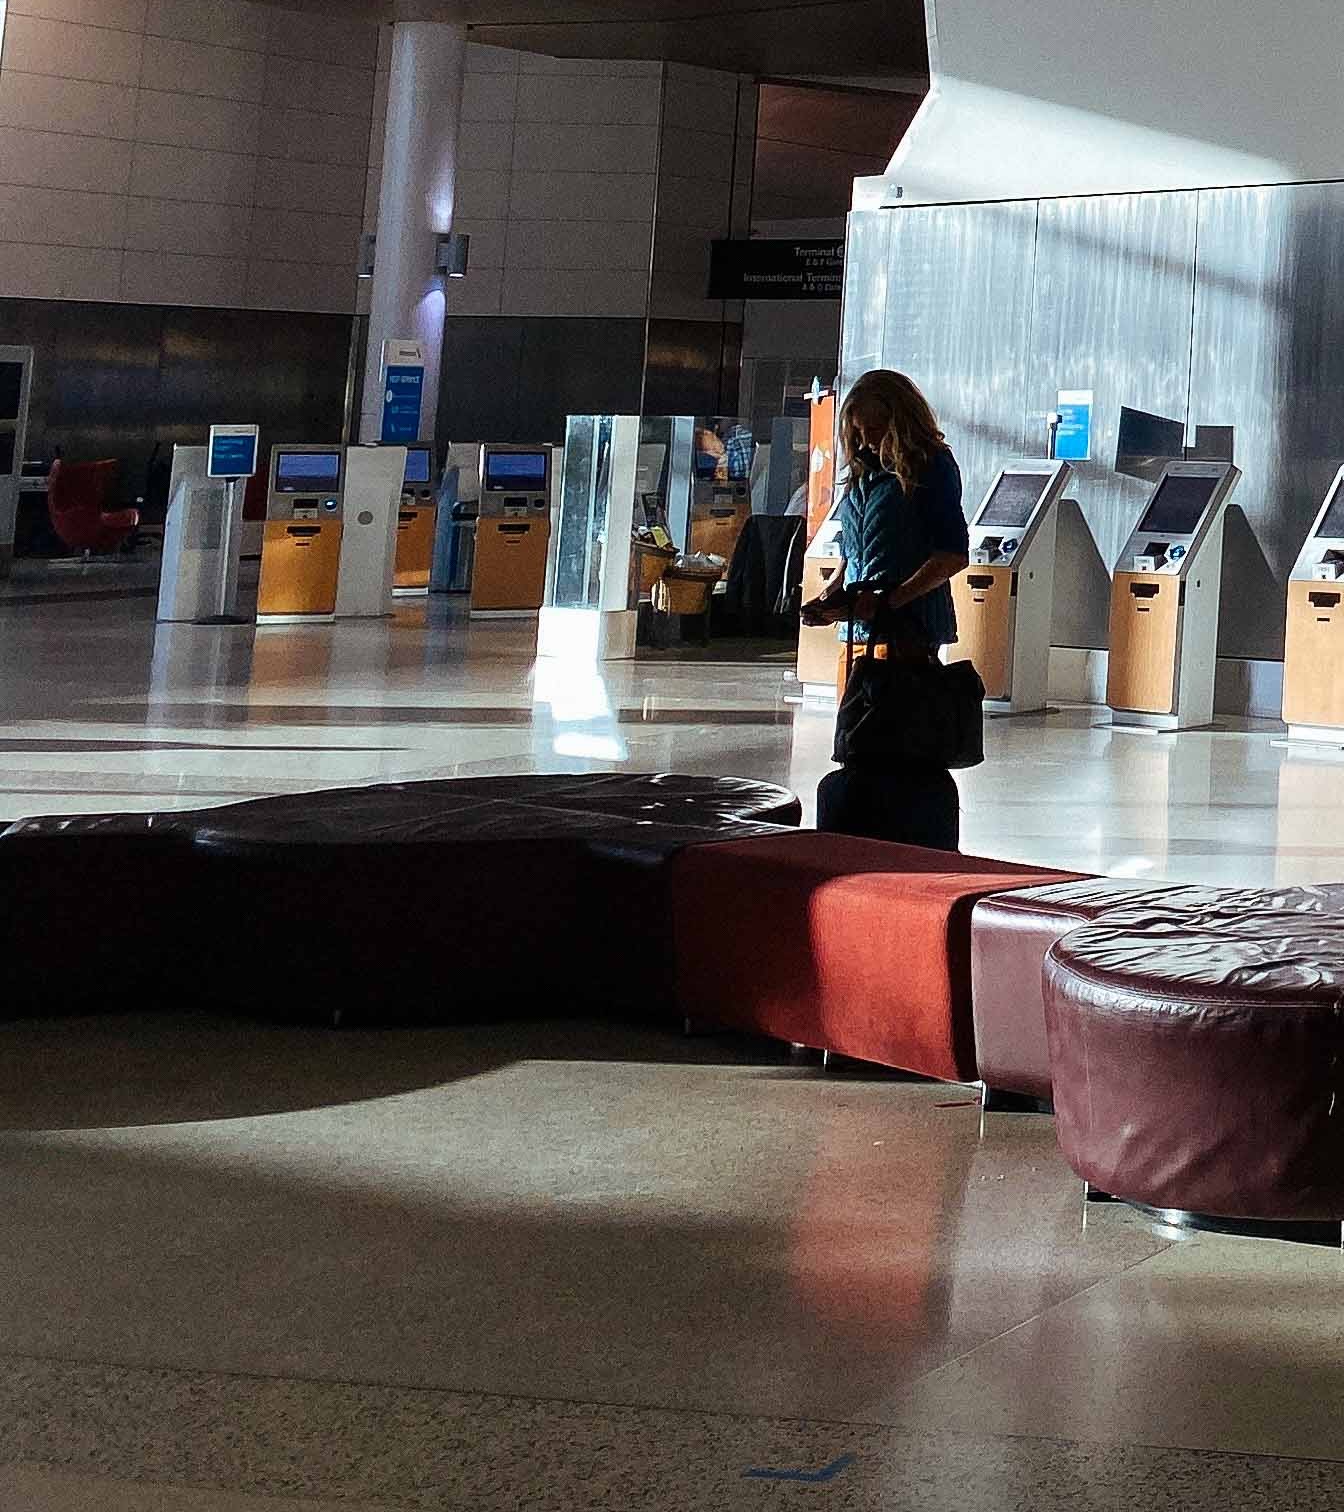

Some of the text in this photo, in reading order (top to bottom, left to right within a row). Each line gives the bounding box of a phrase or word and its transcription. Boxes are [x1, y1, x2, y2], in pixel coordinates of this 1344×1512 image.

[793, 246, 835, 257] Terminal
[743, 272, 842, 282] International Termin
